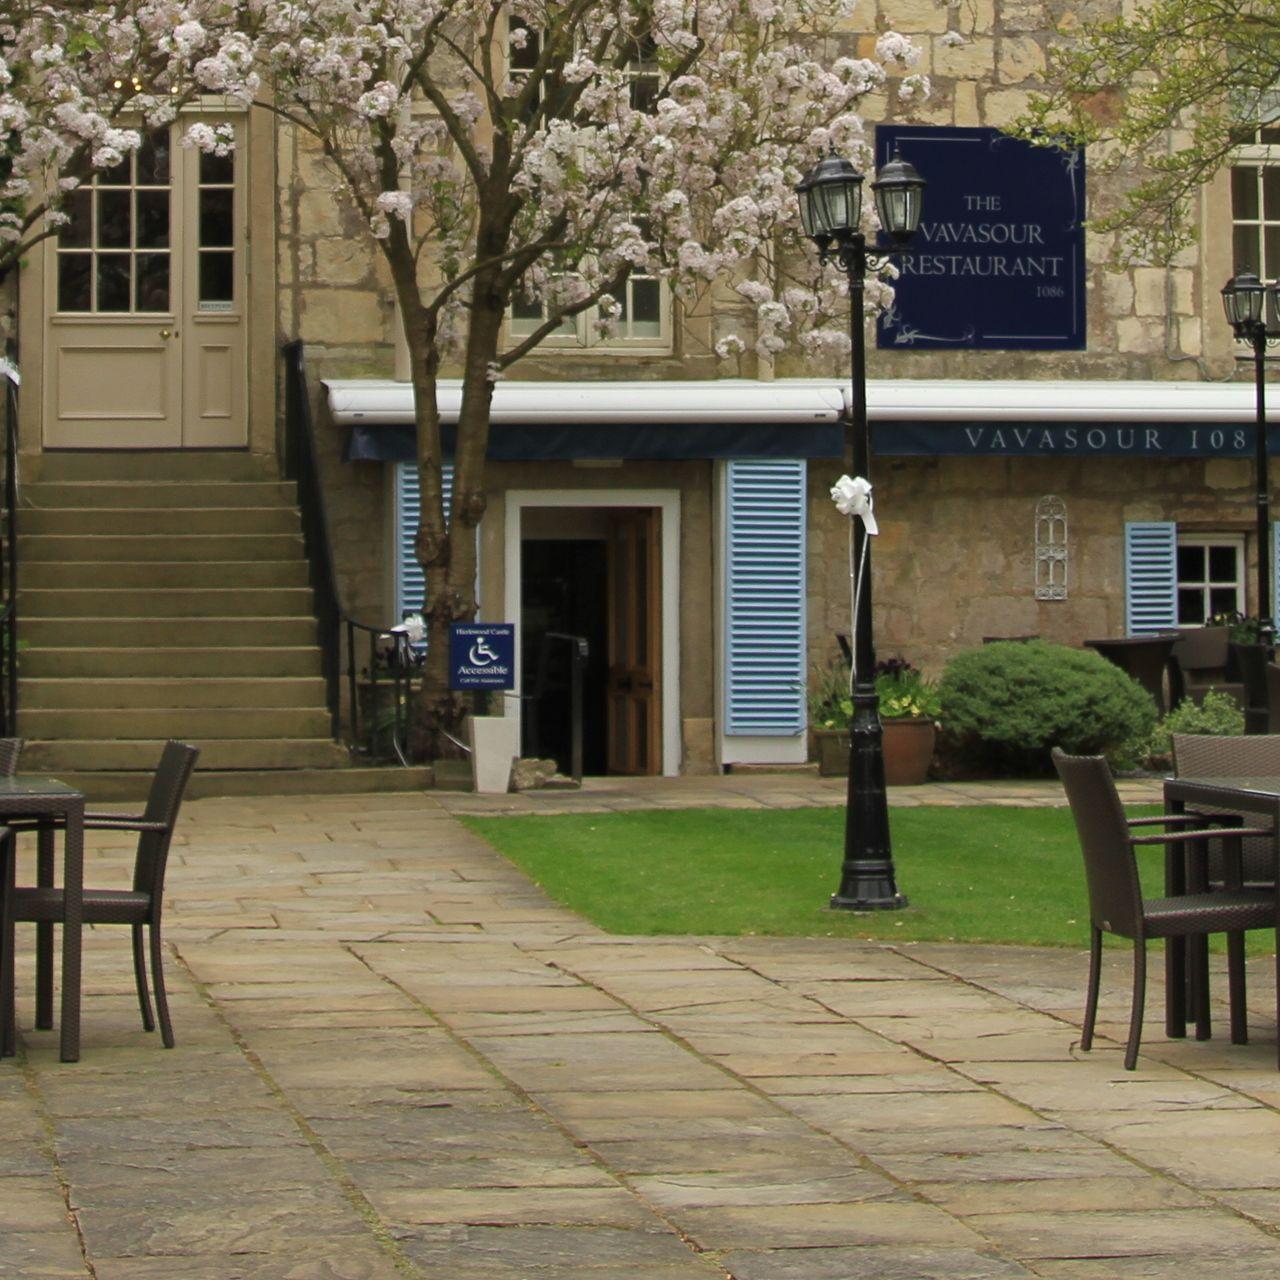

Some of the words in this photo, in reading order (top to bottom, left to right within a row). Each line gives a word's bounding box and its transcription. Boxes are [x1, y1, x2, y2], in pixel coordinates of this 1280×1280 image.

[963, 195, 1001, 211] THE
[920, 223, 1045, 245] VAVASOUR
[902, 255, 1064, 277] RESTAURANT
[1036, 285, 1064, 298] 1086
[964, 427, 1163, 450] VAVASOUR
[1192, 429, 1265, 450] 108
[458, 665, 508, 675] Accessible
